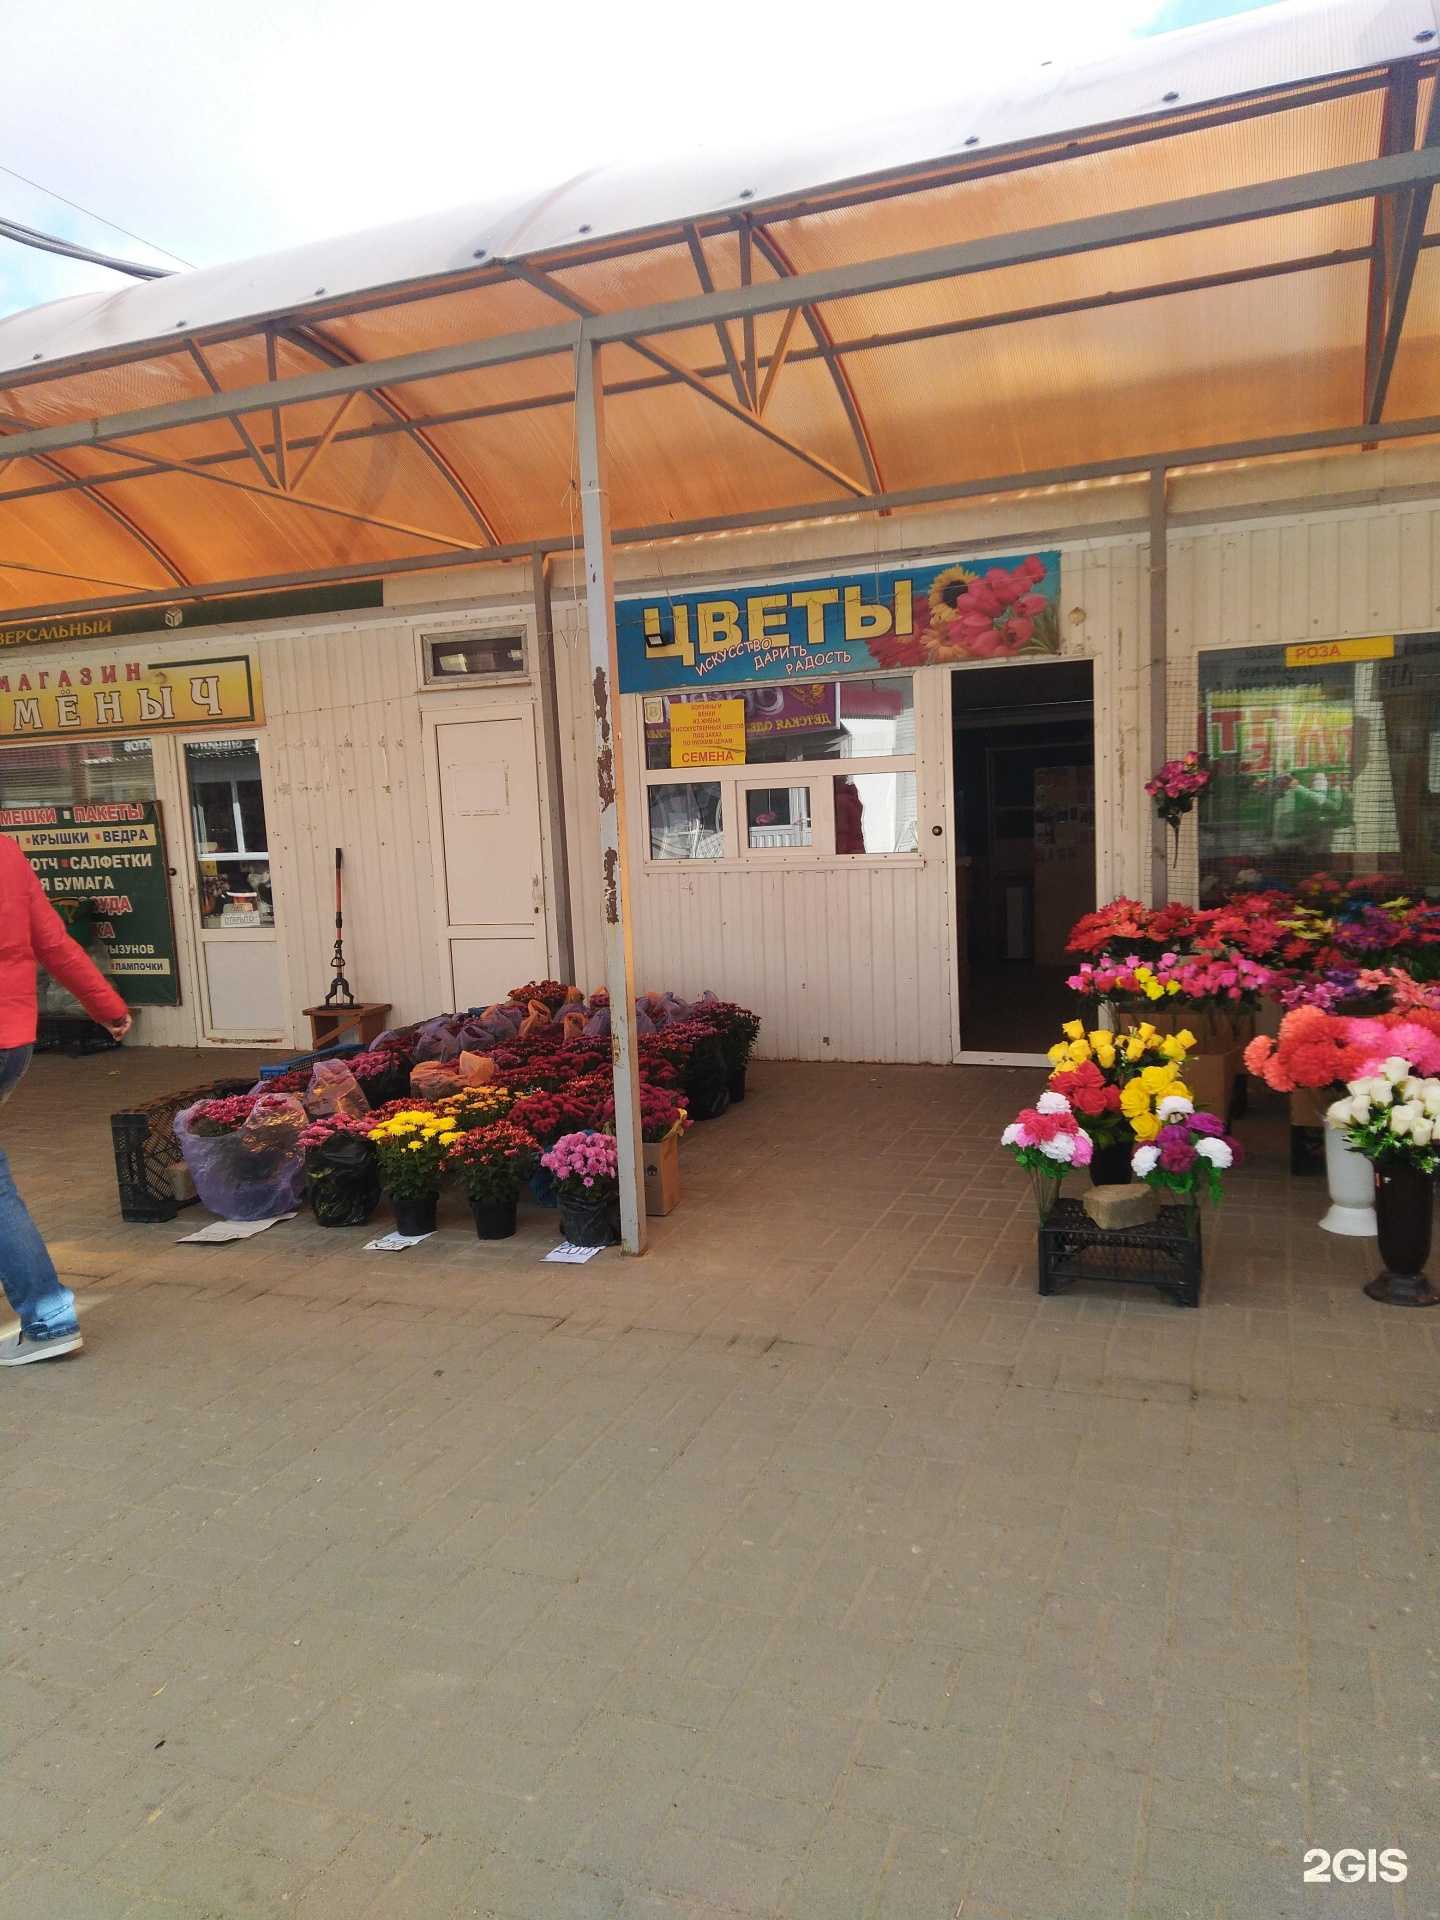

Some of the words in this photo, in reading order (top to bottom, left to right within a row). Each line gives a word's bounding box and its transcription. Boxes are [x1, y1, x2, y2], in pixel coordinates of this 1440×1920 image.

[642, 579, 913, 666] ЦВЕТЫ
[695, 638, 773, 676] ИСКУССТВО
[753, 645, 807, 670] ДАРИТЬ
[1296, 644, 1341, 658] РОЗА
[786, 651, 851, 675] РАДОСТЬ
[681, 751, 734, 763] СЕМЕНА
[0, 808, 57, 826] МЕШКИ
[73, 803, 144, 823] ПАКЕТЫ
[32, 832, 90, 846] КРЫШКИ
[103, 829, 149, 843] ВЕДРА
[27, 857, 59, 871] ОТЧ
[70, 853, 152, 870] САЛФЕТКИ
[54, 876, 114, 891] БУМАГА
[105, 944, 154, 955] ЫЗУНОВ
[115, 961, 163, 972] ЛАМПОЧКИ
